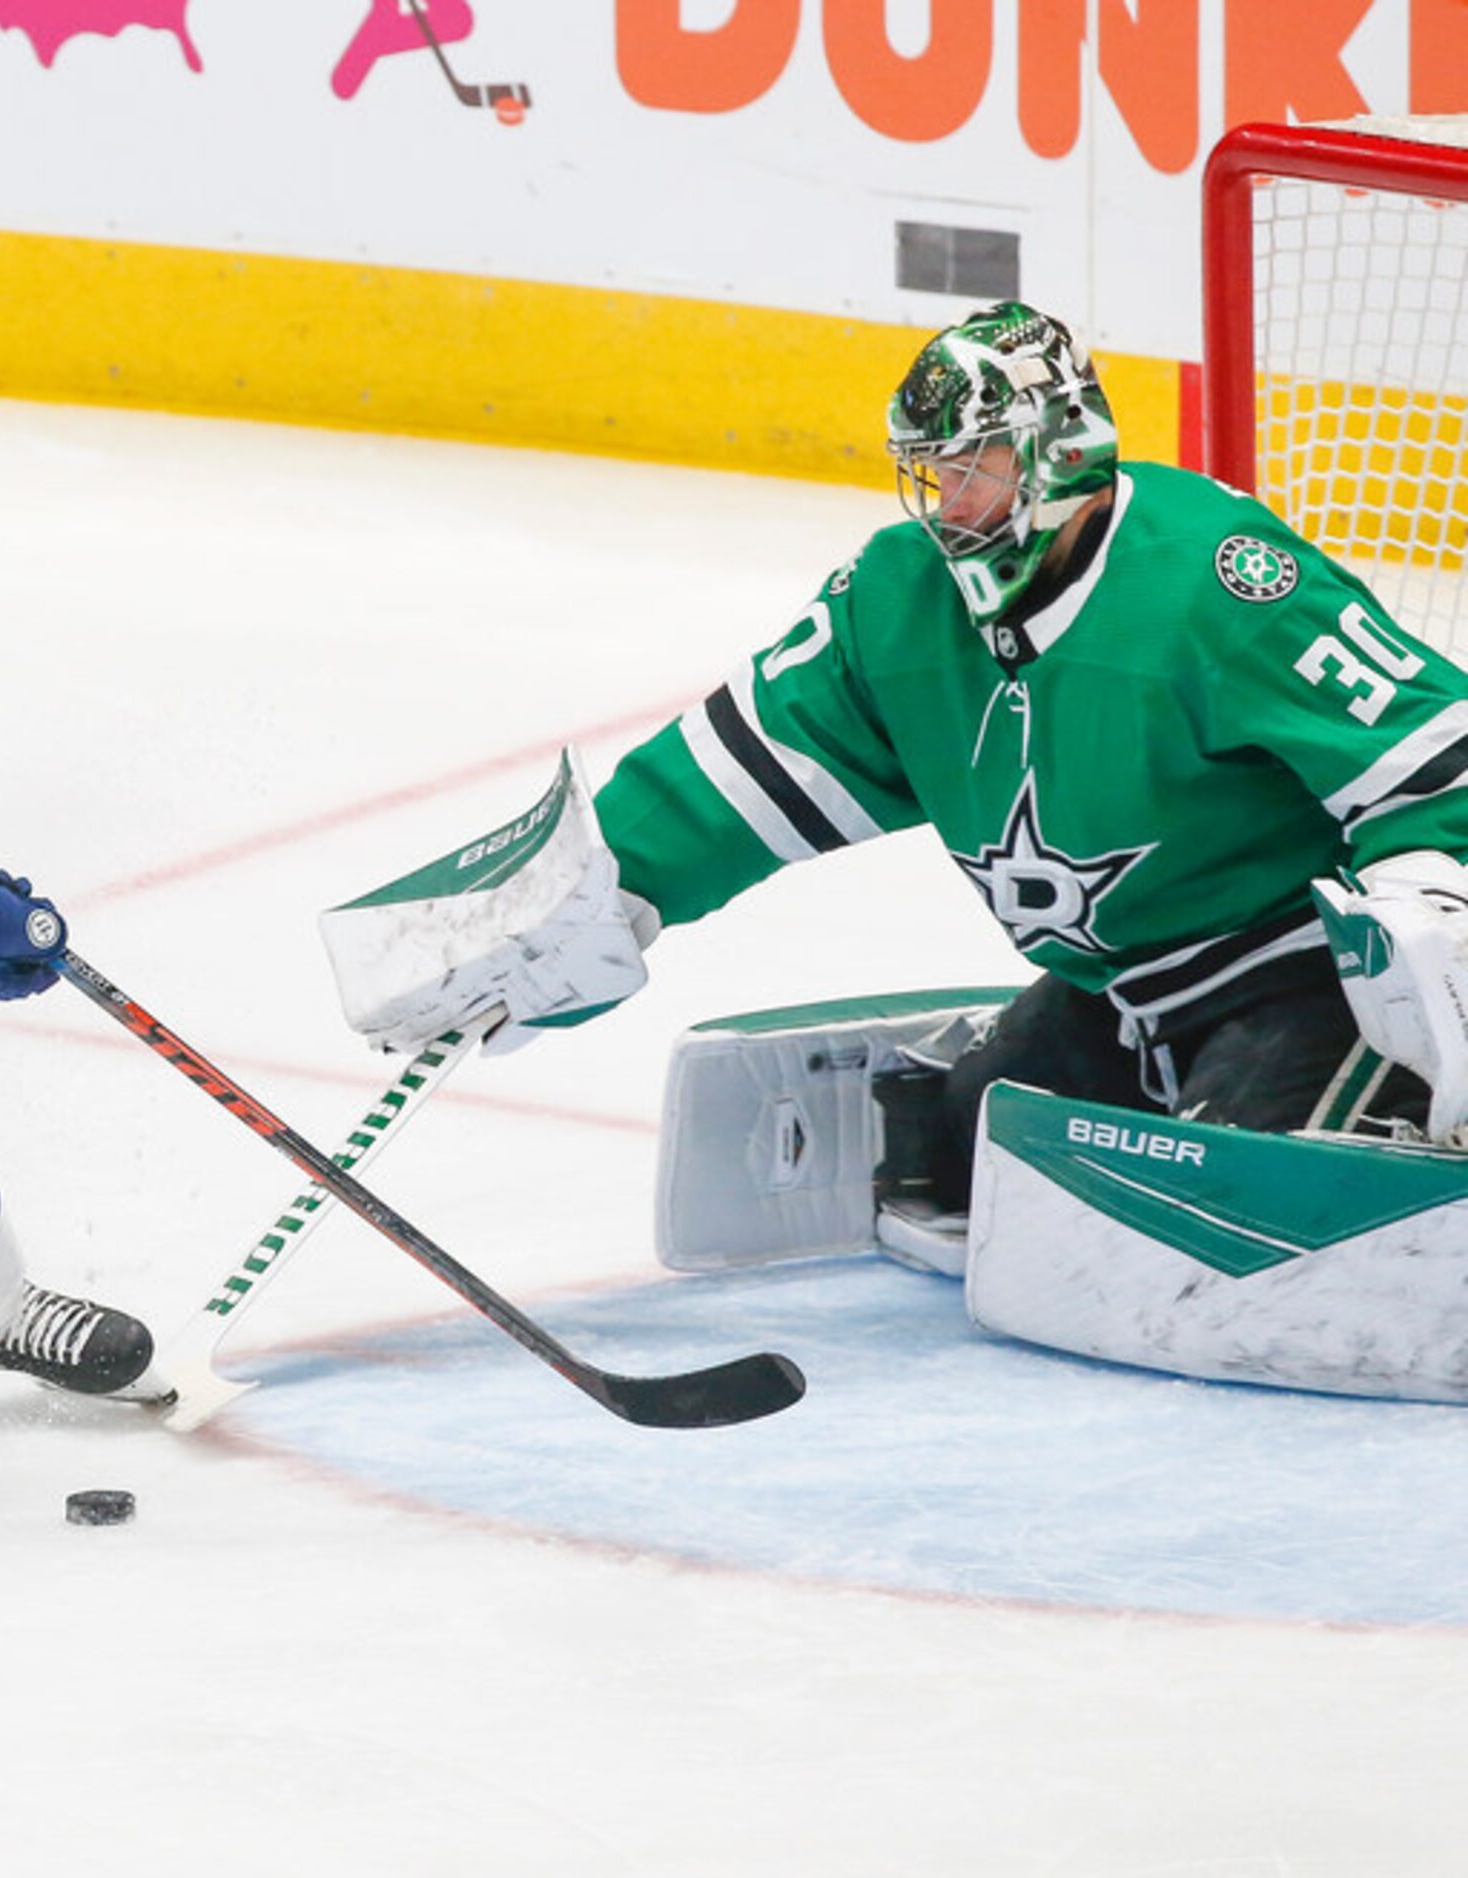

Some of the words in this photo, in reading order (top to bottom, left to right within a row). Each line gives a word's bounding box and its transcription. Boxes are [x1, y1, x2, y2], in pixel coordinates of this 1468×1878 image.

[615, 0, 1468, 190] DUNK
[1292, 601, 1427, 728] 30
[1068, 1117, 1206, 1167] BAUER
